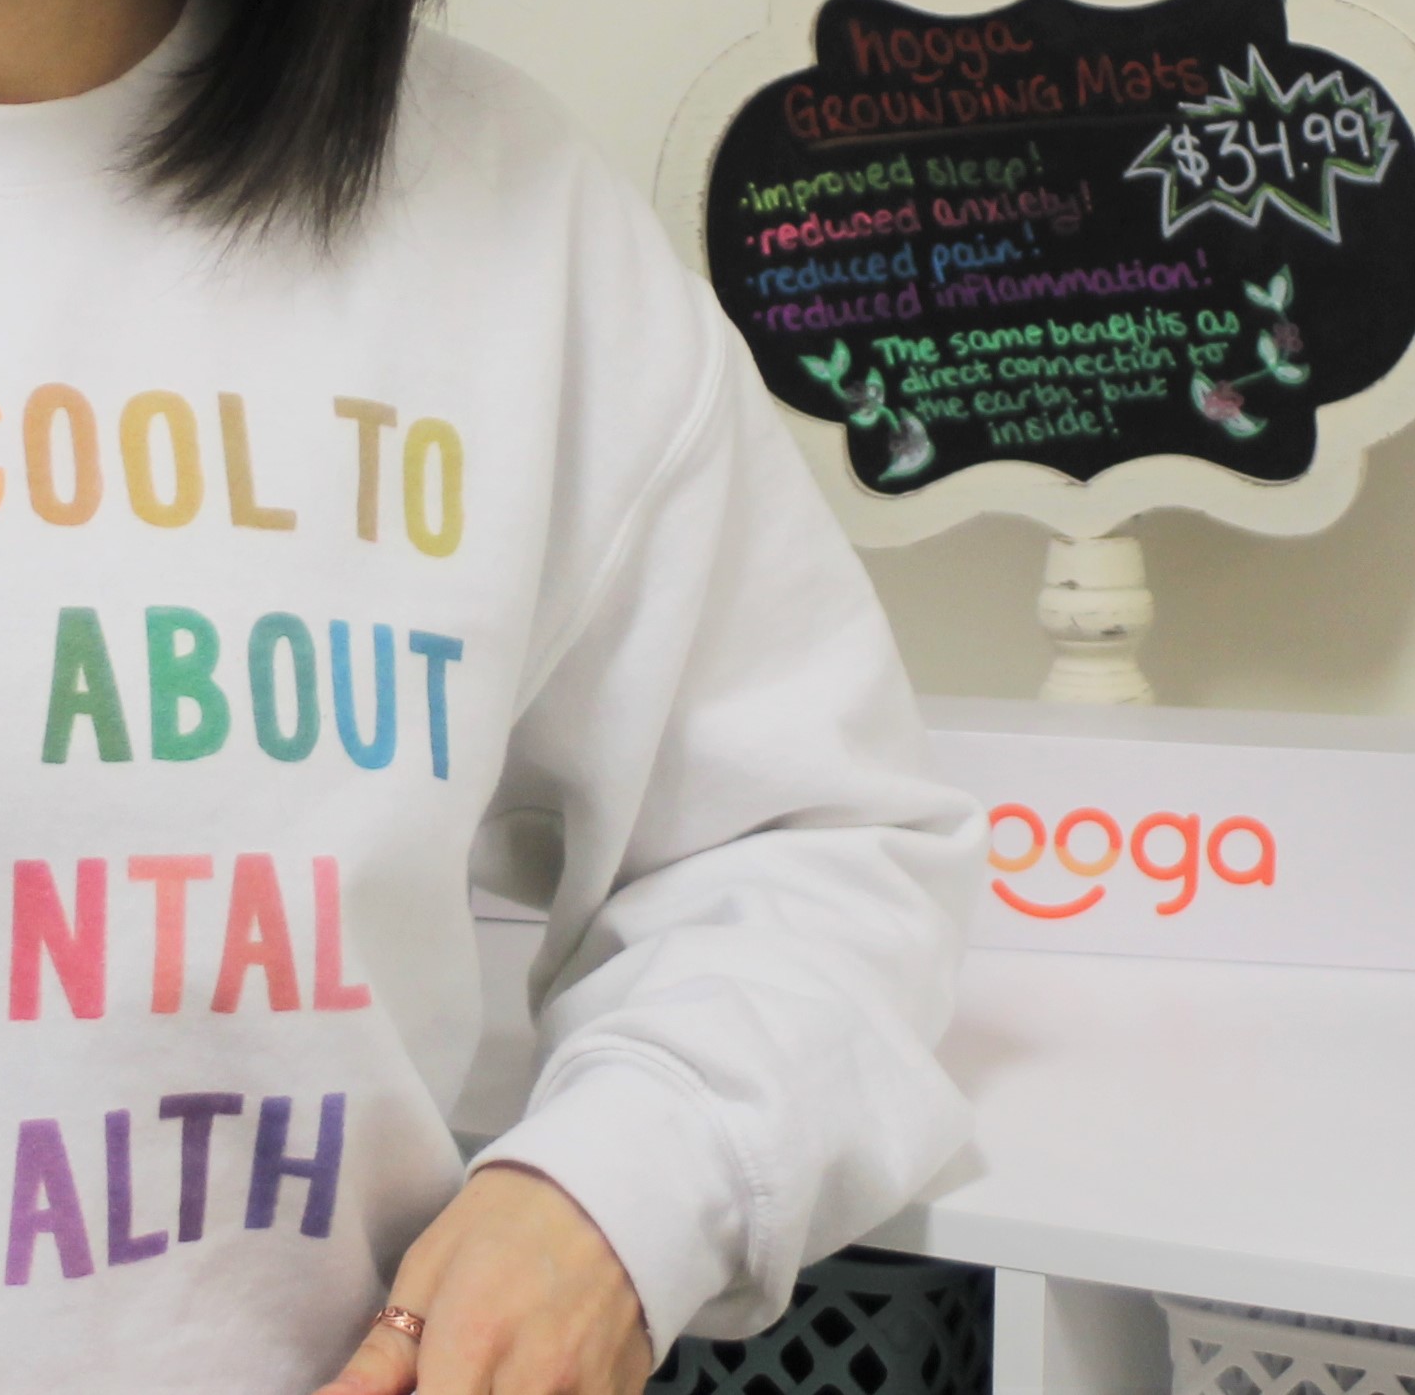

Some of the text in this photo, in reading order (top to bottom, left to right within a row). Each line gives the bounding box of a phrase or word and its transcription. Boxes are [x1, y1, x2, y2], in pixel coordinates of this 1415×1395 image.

[849, 19, 1033, 81] hooga
[1077, 51, 1209, 106] Mats
[926, 141, 1043, 190] sleep!
[1171, 108, 1371, 194] $34.99
[759, 198, 922, 255] reduced
[758, 220, 1042, 296] reduced pain!
[766, 247, 1212, 331] reduced inflammation!
[872, 306, 1240, 367] The same benefits as
[901, 341, 1229, 395] direct connection to
[988, 404, 1120, 446] inside!
[333, 395, 464, 558] TO
[40, 605, 464, 781] ABOUT
[988, 803, 1276, 916] ooga
